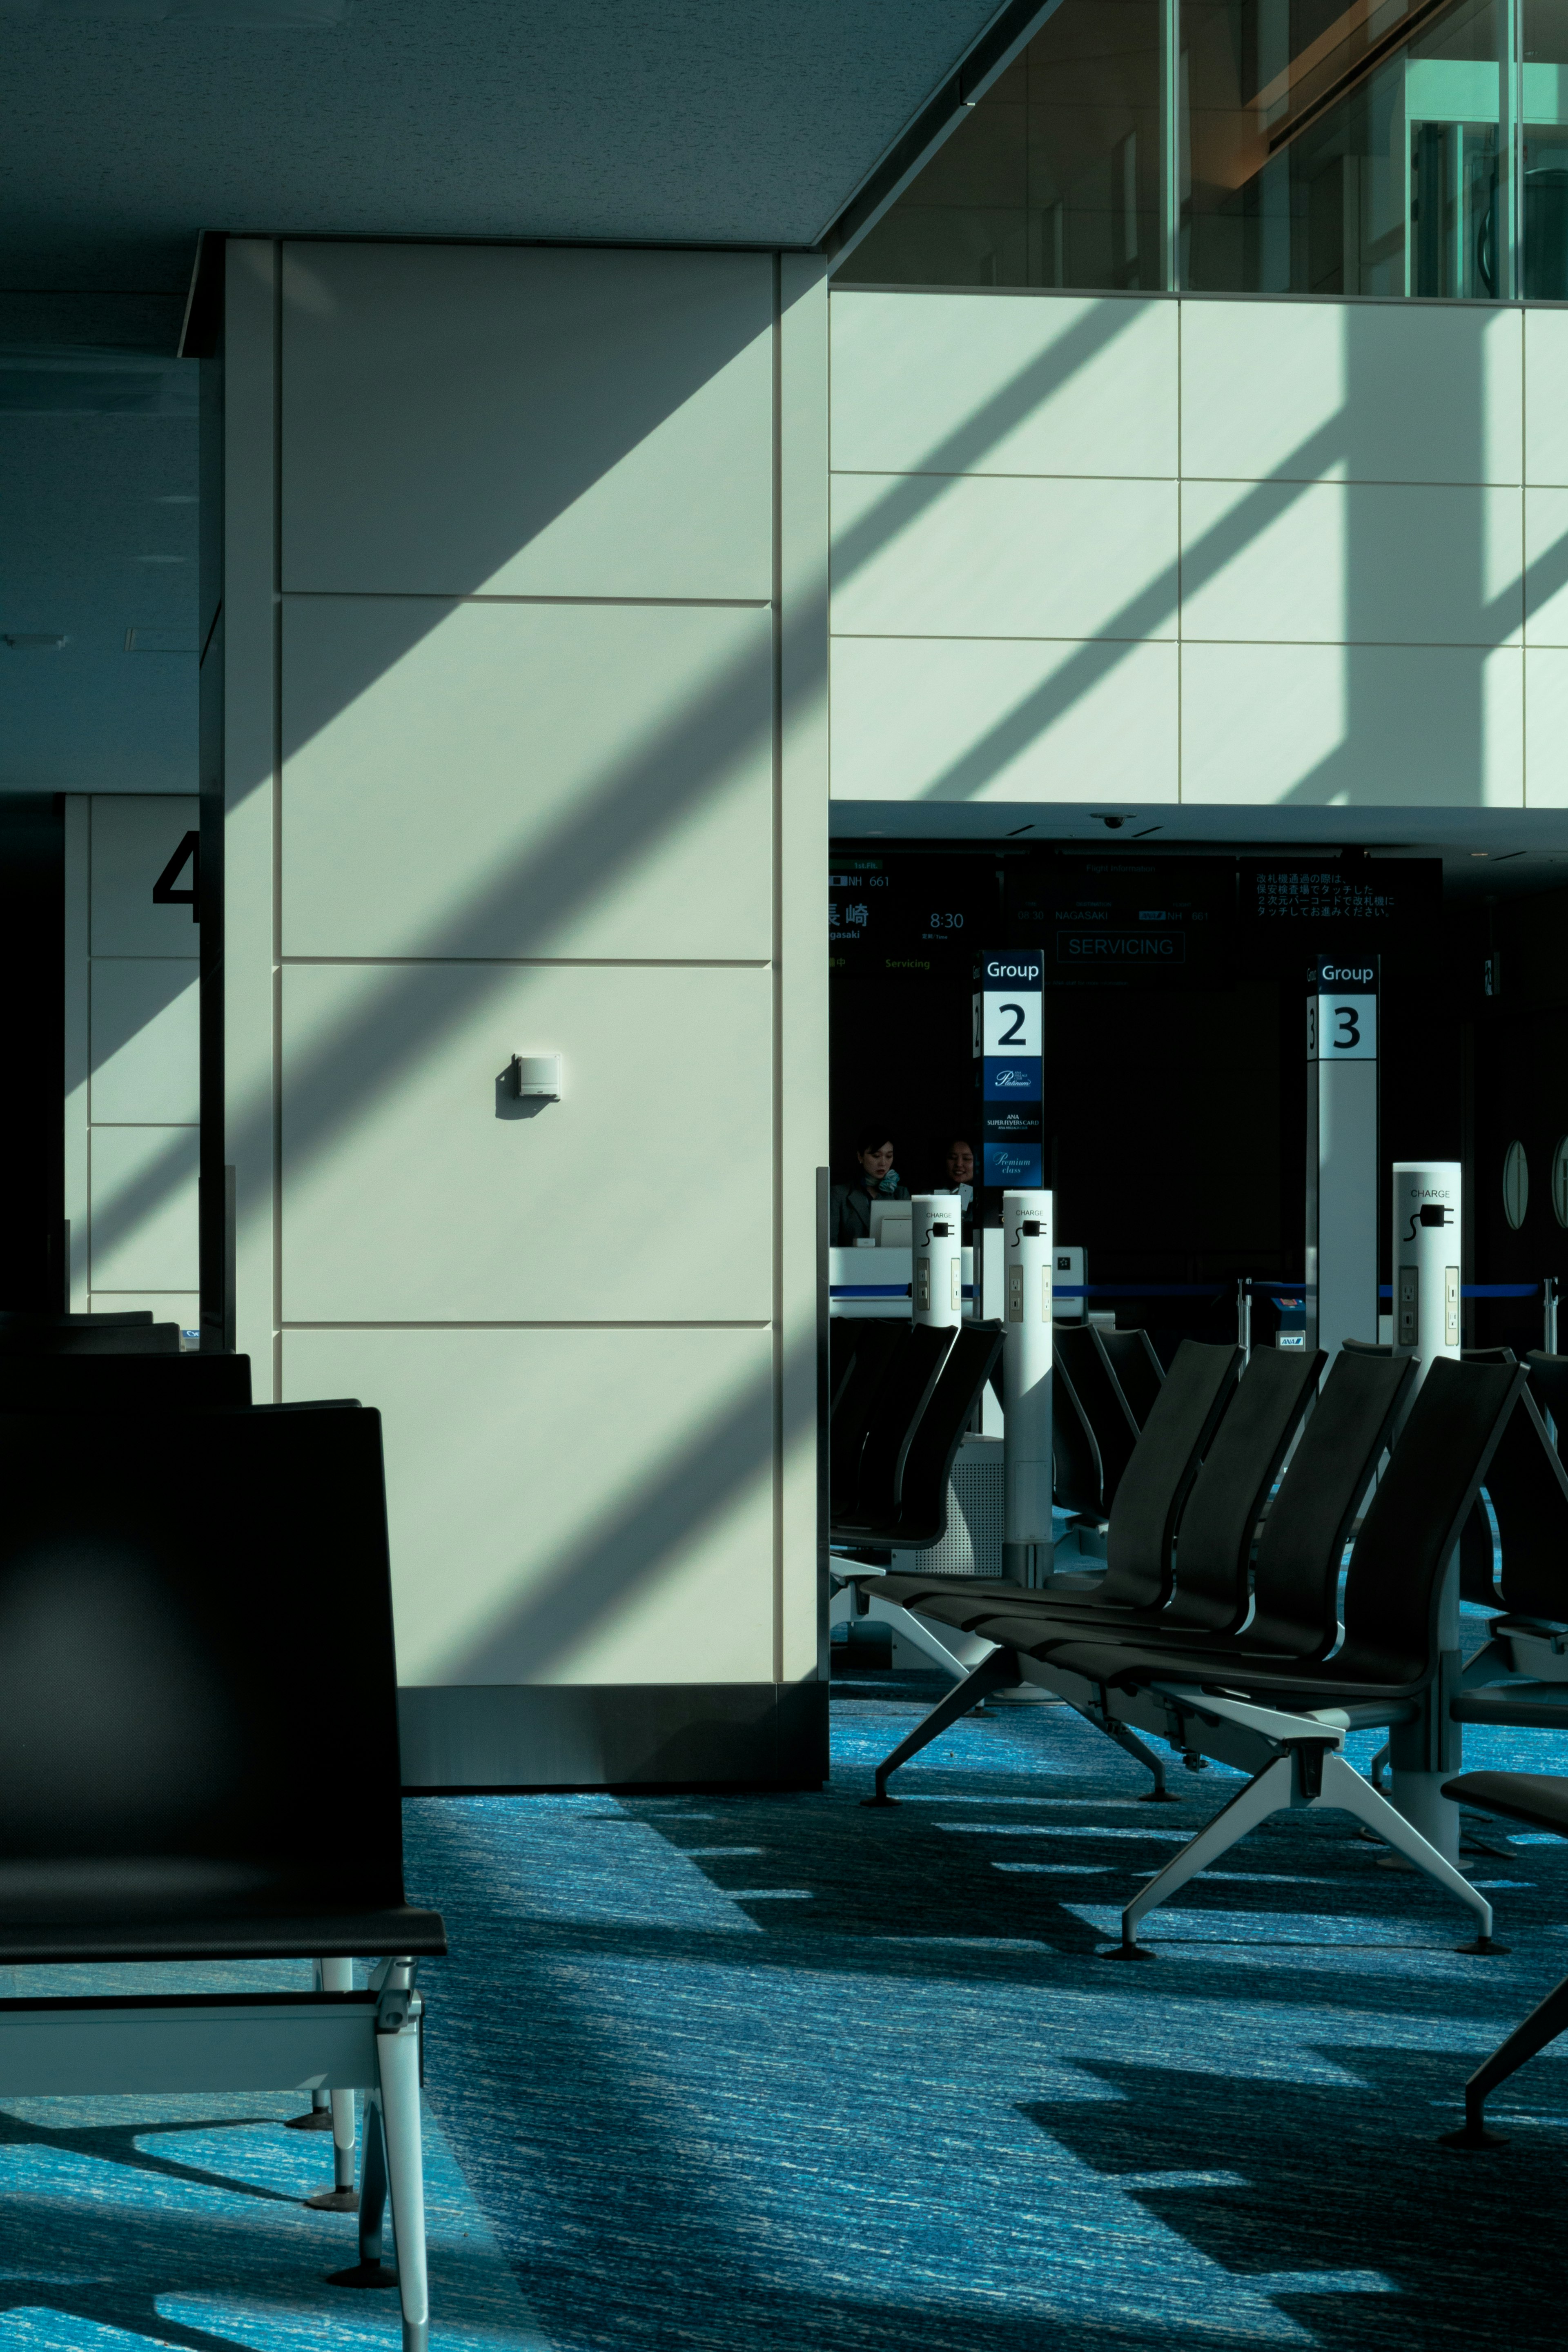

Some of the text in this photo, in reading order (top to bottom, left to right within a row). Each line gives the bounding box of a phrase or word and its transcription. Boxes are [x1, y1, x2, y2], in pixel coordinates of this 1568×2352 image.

[1086, 864, 1156, 873] Flight Information
[153, 831, 200, 923] 4
[849, 876, 889, 886] NH 661
[1256, 873, 1346, 884] 改札機通過の際は、
[1256, 884, 1373, 895] 保安検査場でタッチした
[1018, 911, 1044, 920] 08:30
[1055, 911, 1108, 920] NAGASAKI
[1167, 912, 1182, 920] NH
[1192, 912, 1208, 920] 661
[1257, 907, 1390, 918] タッチしてお進みください。
[930, 913, 964, 928] 8:30
[1069, 939, 1174, 955] SERVICING
[885, 958, 931, 970] Servicing
[987, 962, 1039, 980] Group
[1322, 965, 1374, 984] Group
[975, 1005, 979, 1047] 2
[998, 1003, 1026, 1045] 2
[1310, 1008, 1315, 1050] 3
[1333, 1007, 1361, 1049] 3
[995, 1070, 1031, 1086] Platinum
[993, 1152, 1031, 1166] Premium
[1002, 1165, 1021, 1174] class
[1410, 1189, 1451, 1198] CHARGE
